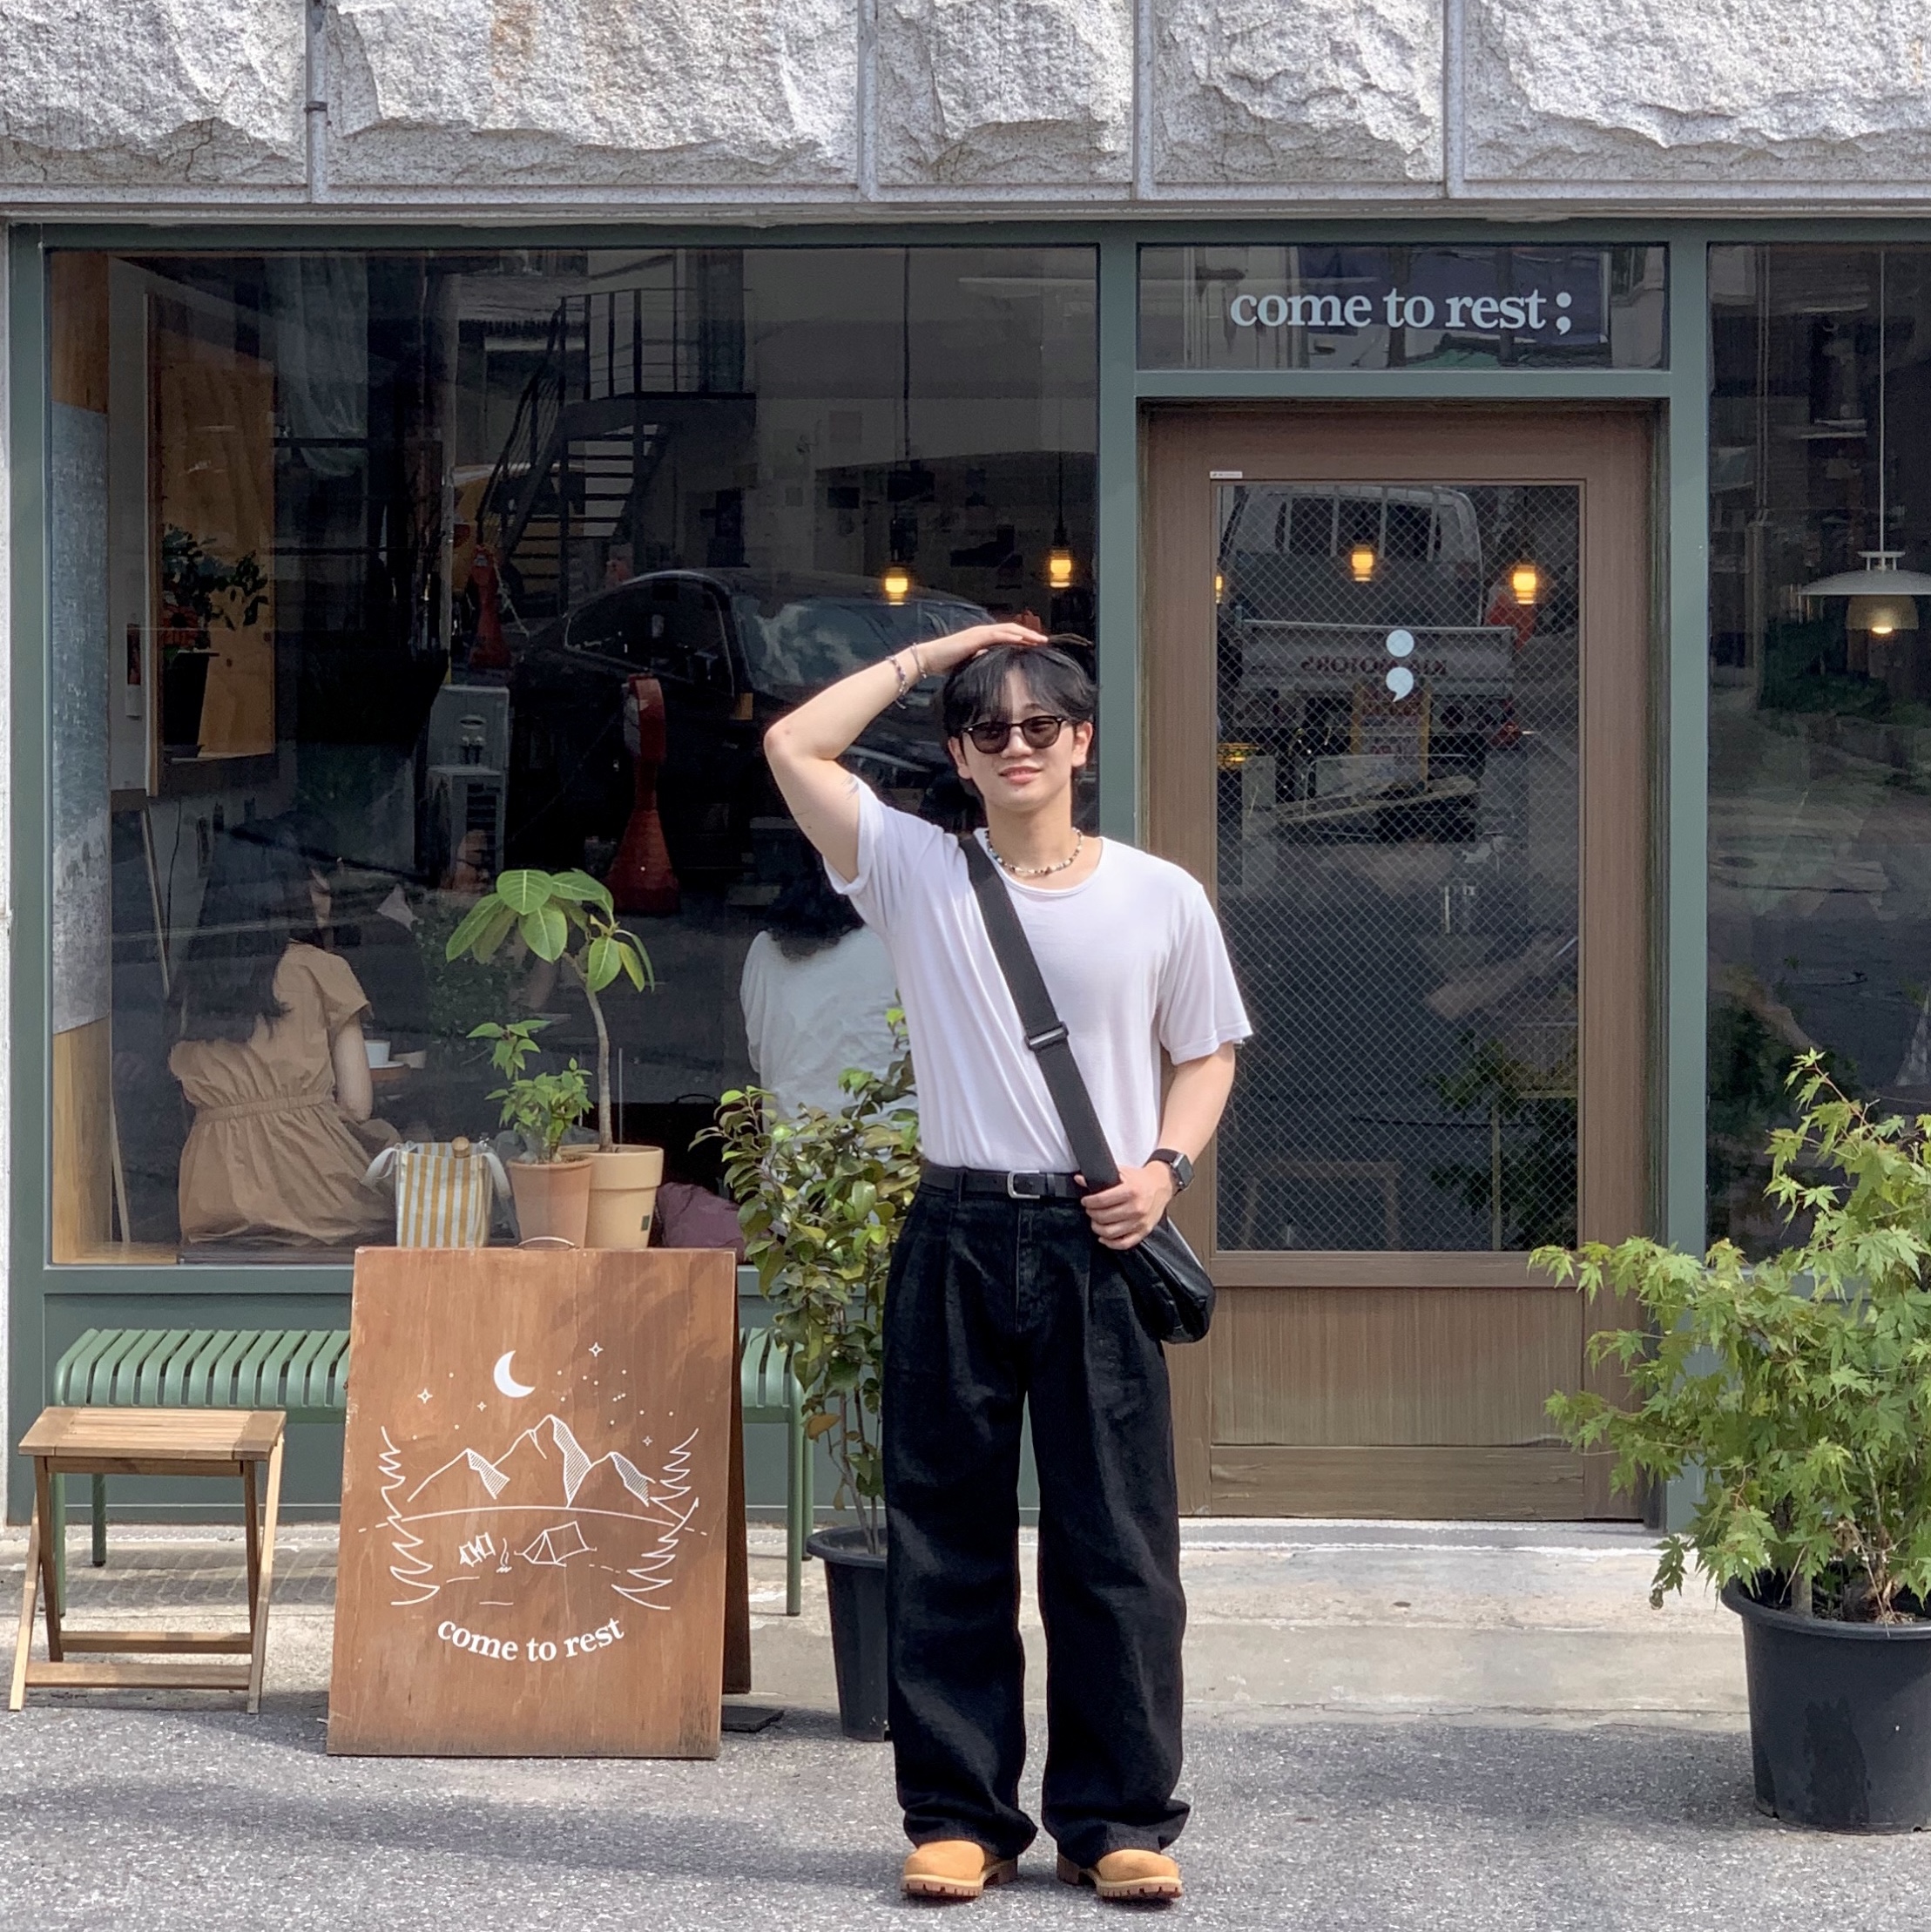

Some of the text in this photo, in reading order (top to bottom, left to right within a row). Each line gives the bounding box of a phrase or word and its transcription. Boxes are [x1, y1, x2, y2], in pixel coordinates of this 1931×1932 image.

[1230, 294, 1373, 328] come
[1382, 288, 1435, 328] to
[437, 1617, 626, 1662] come to rest
